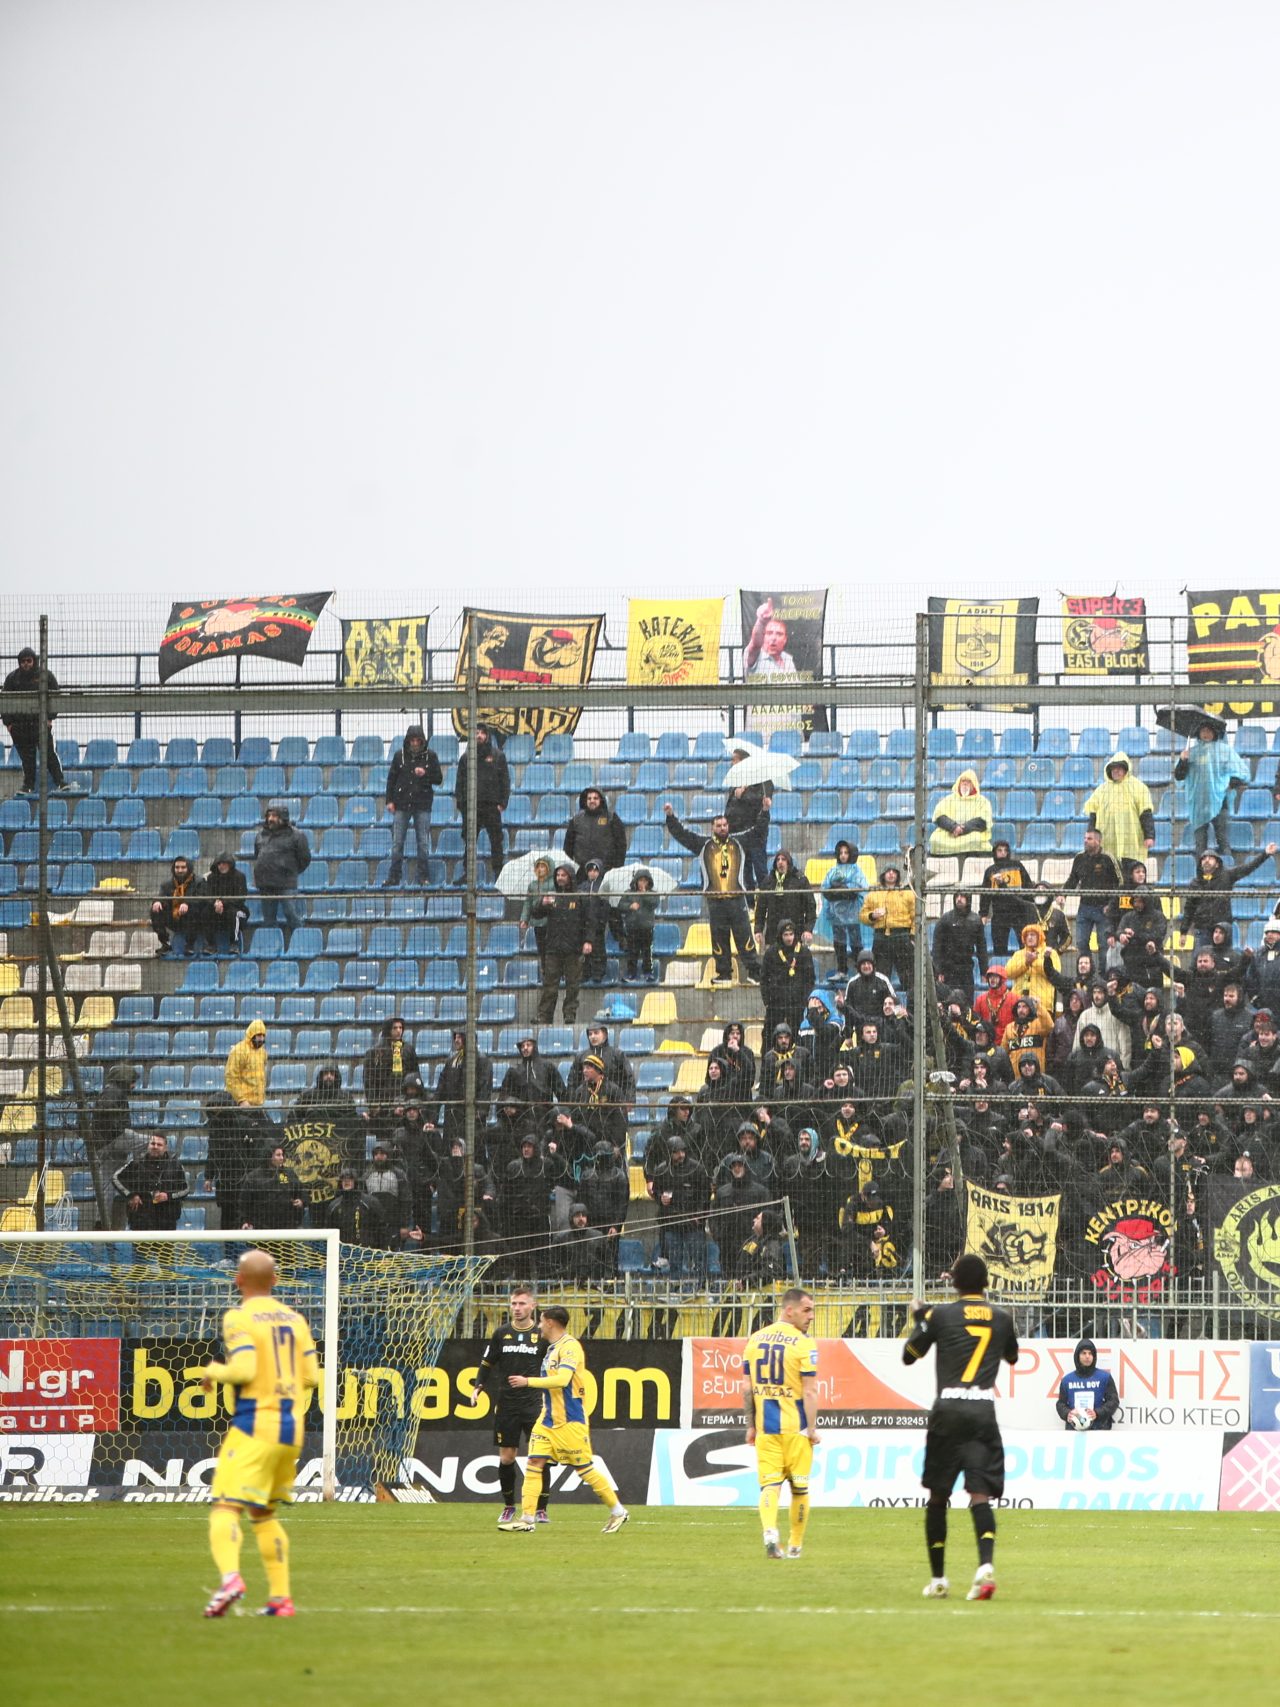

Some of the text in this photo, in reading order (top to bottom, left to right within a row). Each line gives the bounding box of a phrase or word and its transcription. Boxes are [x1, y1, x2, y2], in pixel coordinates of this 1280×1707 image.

[1067, 597, 1145, 617] SUPER-3
[639, 616, 704, 661] KATERINI
[1067, 653, 1146, 669] EAST BLOCK
[284, 1122, 337, 1142] WEST
[970, 1189, 1055, 1218] ARIS 1914
[1230, 1193, 1262, 1222] ARIS
[963, 1305, 993, 1321] SISTO
[271, 1326, 295, 1378] 17
[502, 1343, 538, 1355] novibet
[961, 1326, 992, 1382] 7
[756, 1343, 785, 1385] 20
[753, 1386, 793, 1398] ΑΛΤΣΑΣ
[702, 1416, 736, 1425] ΤΕΡΜΑ
[847, 1417, 869, 1426] ΤΗΛ.
[871, 1417, 893, 1426] 2710
[896, 1417, 928, 1426] 232451
[1183, 1408, 1240, 1426] ΚΤΕΟ
[1058, 1491, 1206, 1511] DAIKIN
